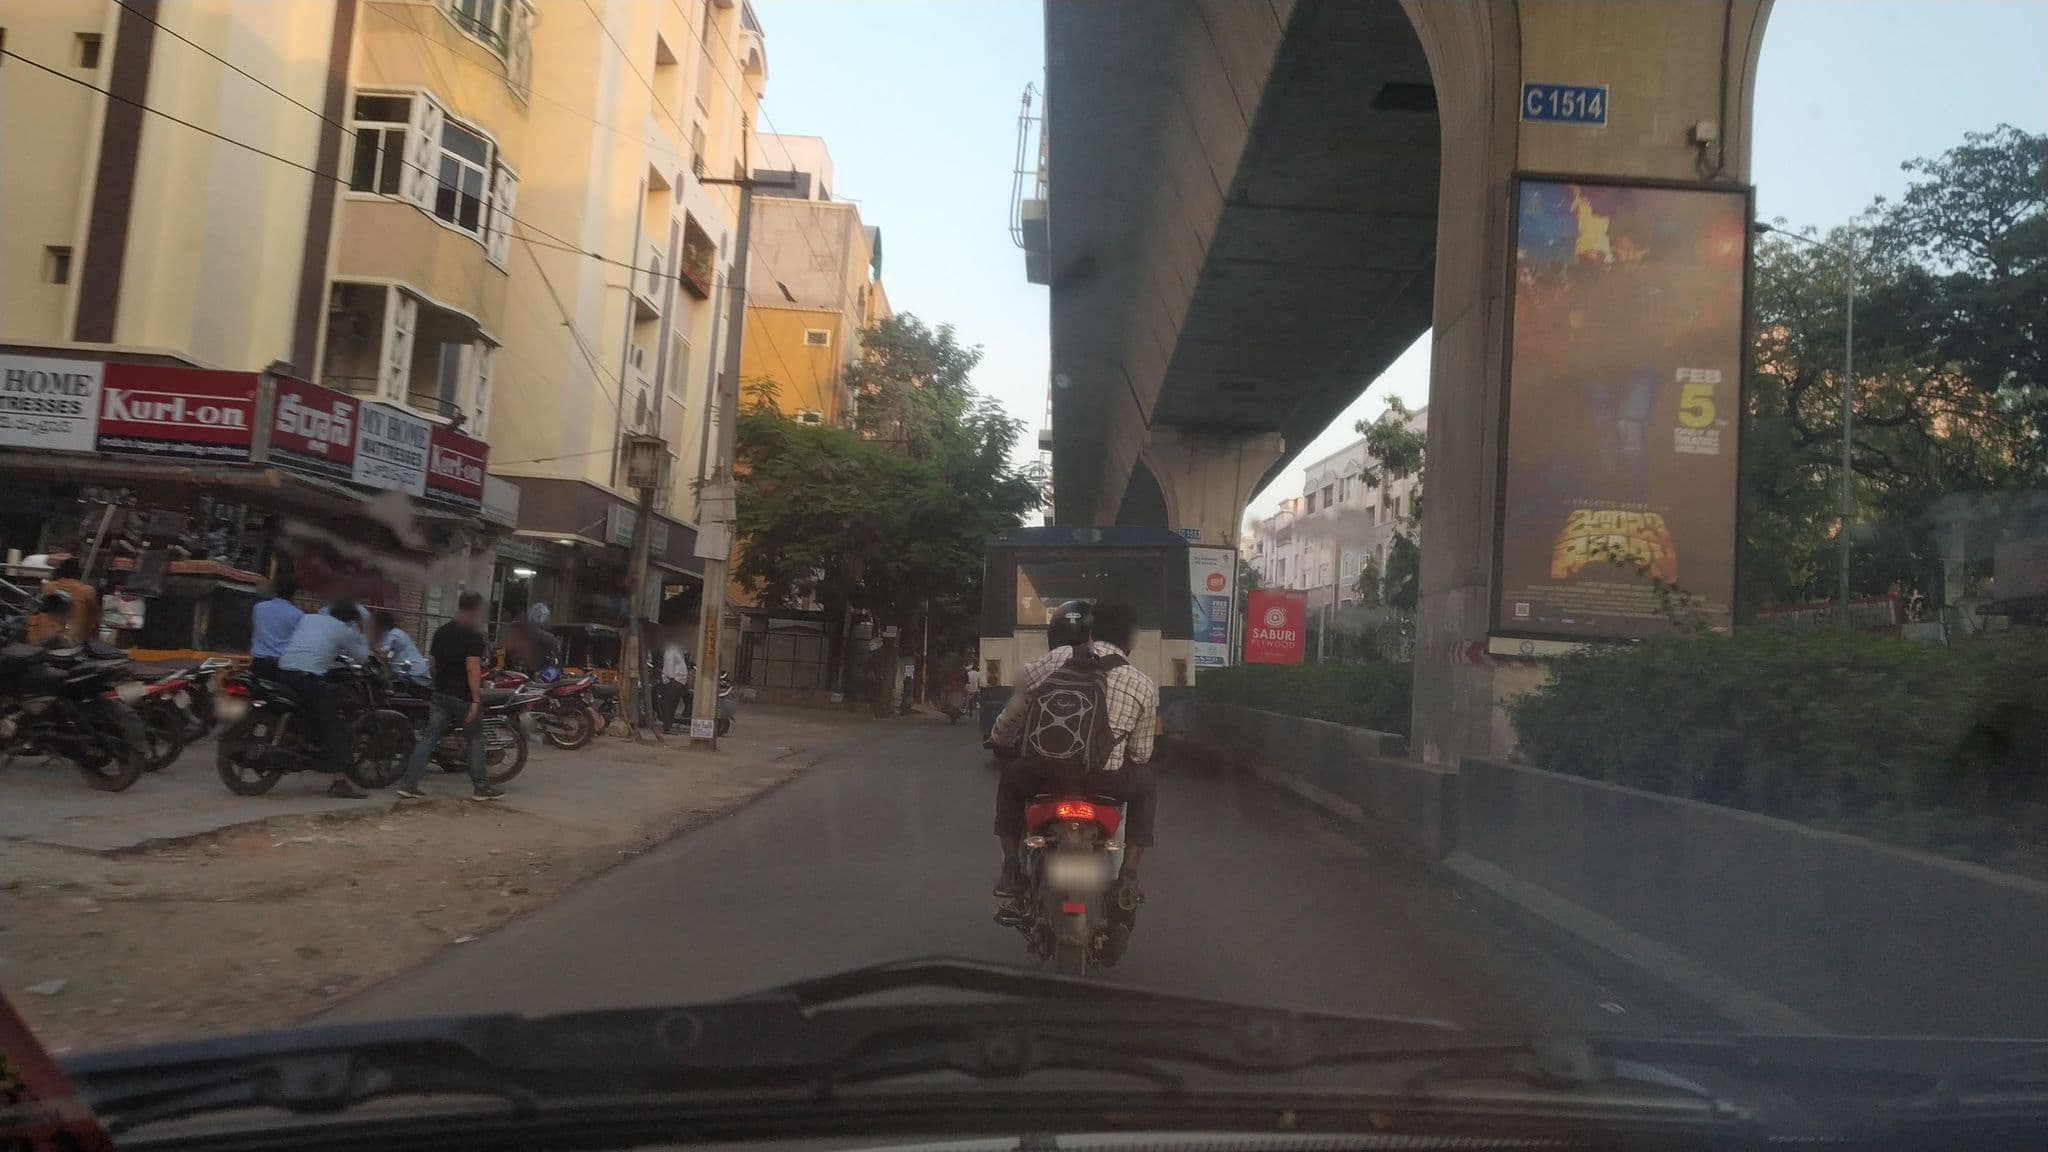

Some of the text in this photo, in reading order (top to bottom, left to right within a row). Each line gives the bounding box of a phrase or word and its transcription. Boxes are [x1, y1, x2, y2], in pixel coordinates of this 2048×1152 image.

[1527, 88, 1602, 119] C 1514
[5, 369, 93, 397] HOME
[1676, 367, 1722, 384] FEB
[104, 389, 246, 426] Kurl-on
[1679, 383, 1716, 428] 5
[431, 443, 482, 484] Kurl-on
[1252, 627, 1296, 641] SABURI
